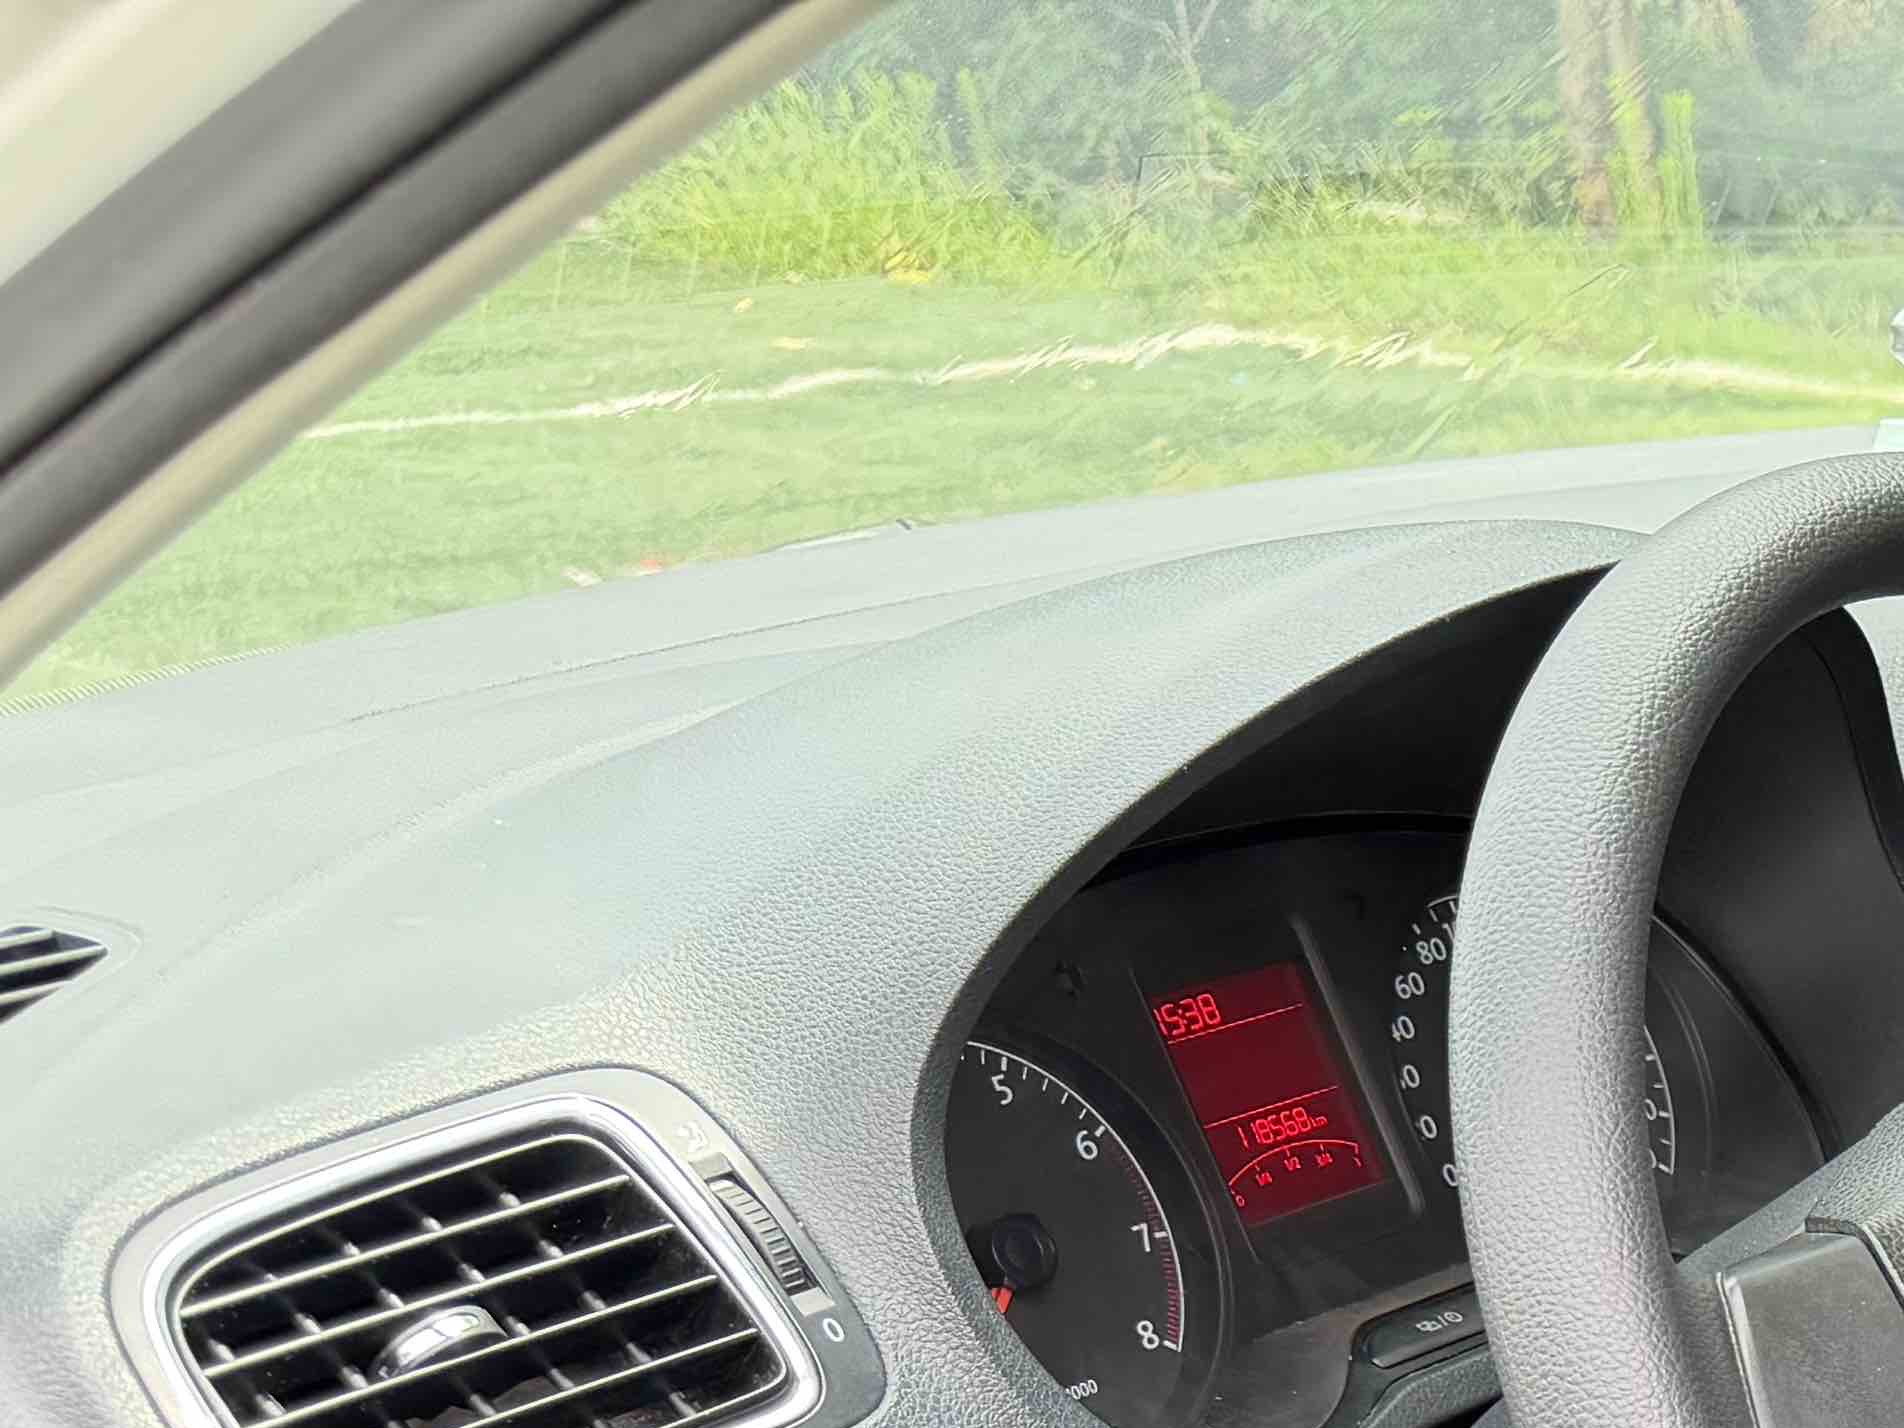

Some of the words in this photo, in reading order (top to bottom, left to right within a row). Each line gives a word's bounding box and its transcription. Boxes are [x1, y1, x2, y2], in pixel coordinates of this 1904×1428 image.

[1415, 937, 1447, 965] 80
[1394, 972, 1425, 999] 60
[1153, 993, 1221, 1036] 15:38
[991, 1073, 1013, 1105] 5
[1076, 1129, 1099, 1161] 6
[1130, 1223, 1152, 1253] 7
[822, 1318, 845, 1343] 0
[1137, 1320, 1161, 1350] 8
